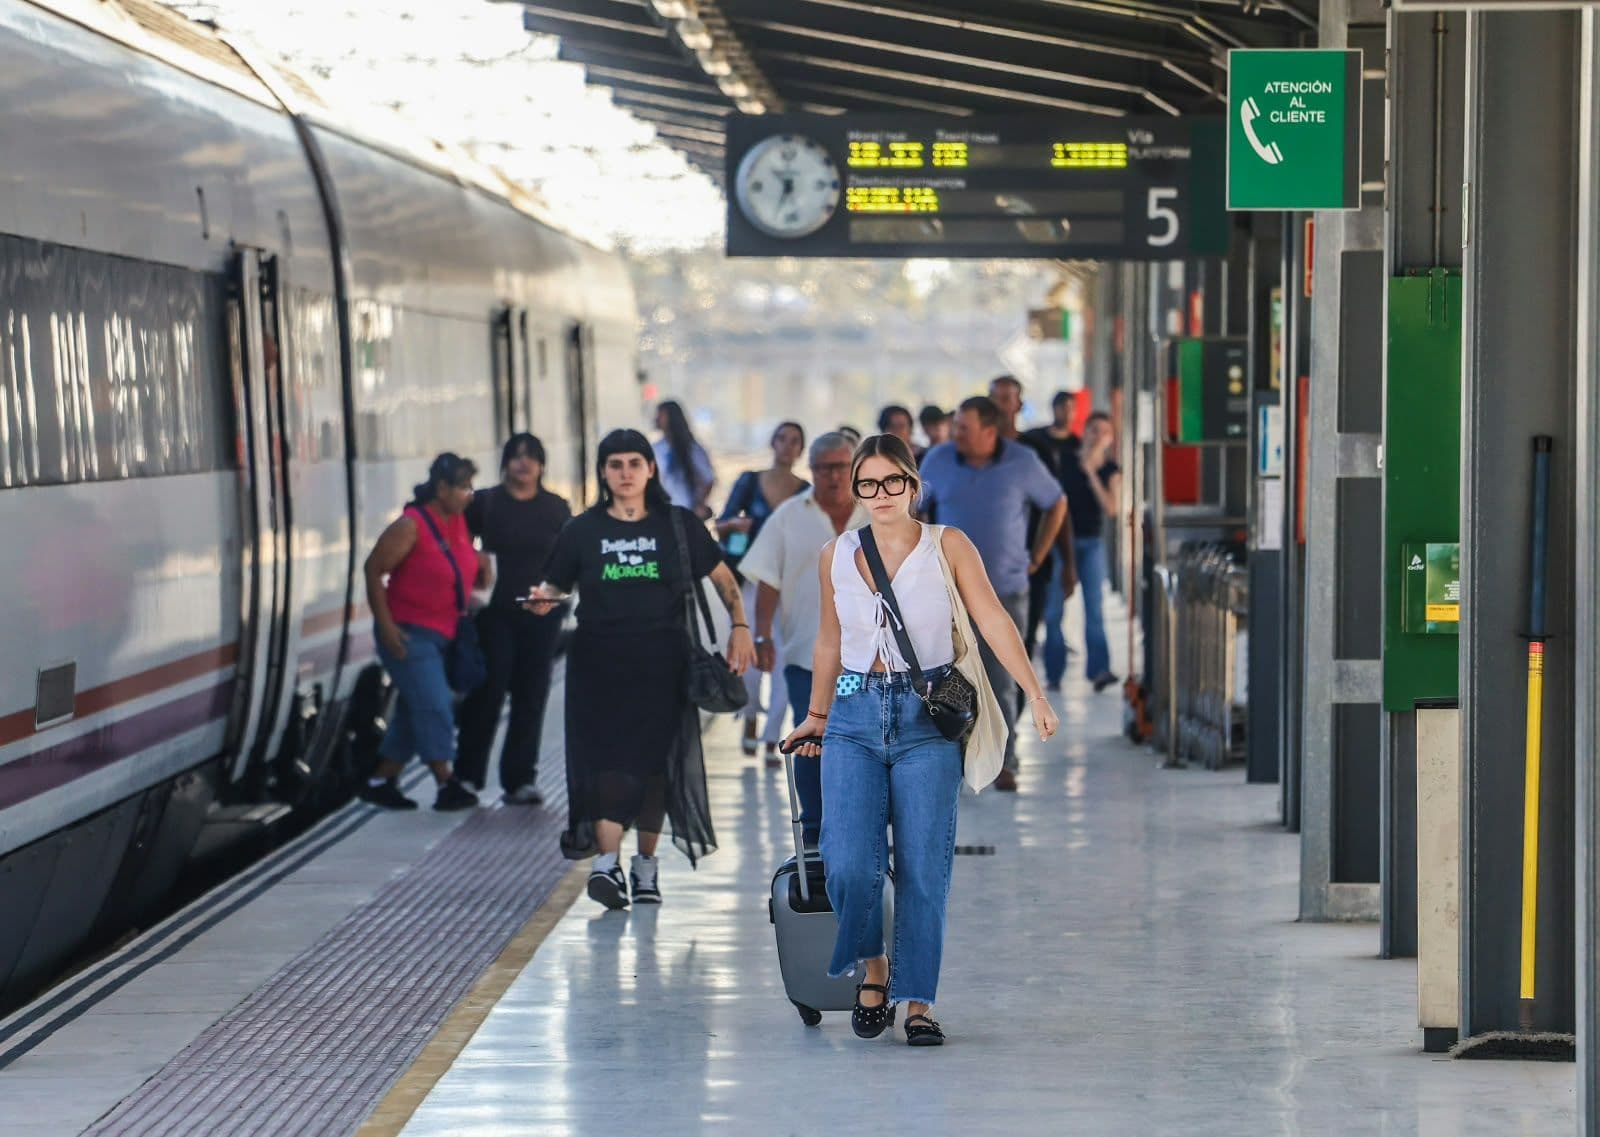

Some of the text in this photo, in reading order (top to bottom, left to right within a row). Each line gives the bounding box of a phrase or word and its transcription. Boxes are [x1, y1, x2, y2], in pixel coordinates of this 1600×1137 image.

[1264, 80, 1332, 94] ATENCIÓN
[1289, 96, 1306, 108] AL
[1270, 111, 1326, 123] CLIENTE
[1147, 187, 1179, 246] 5
